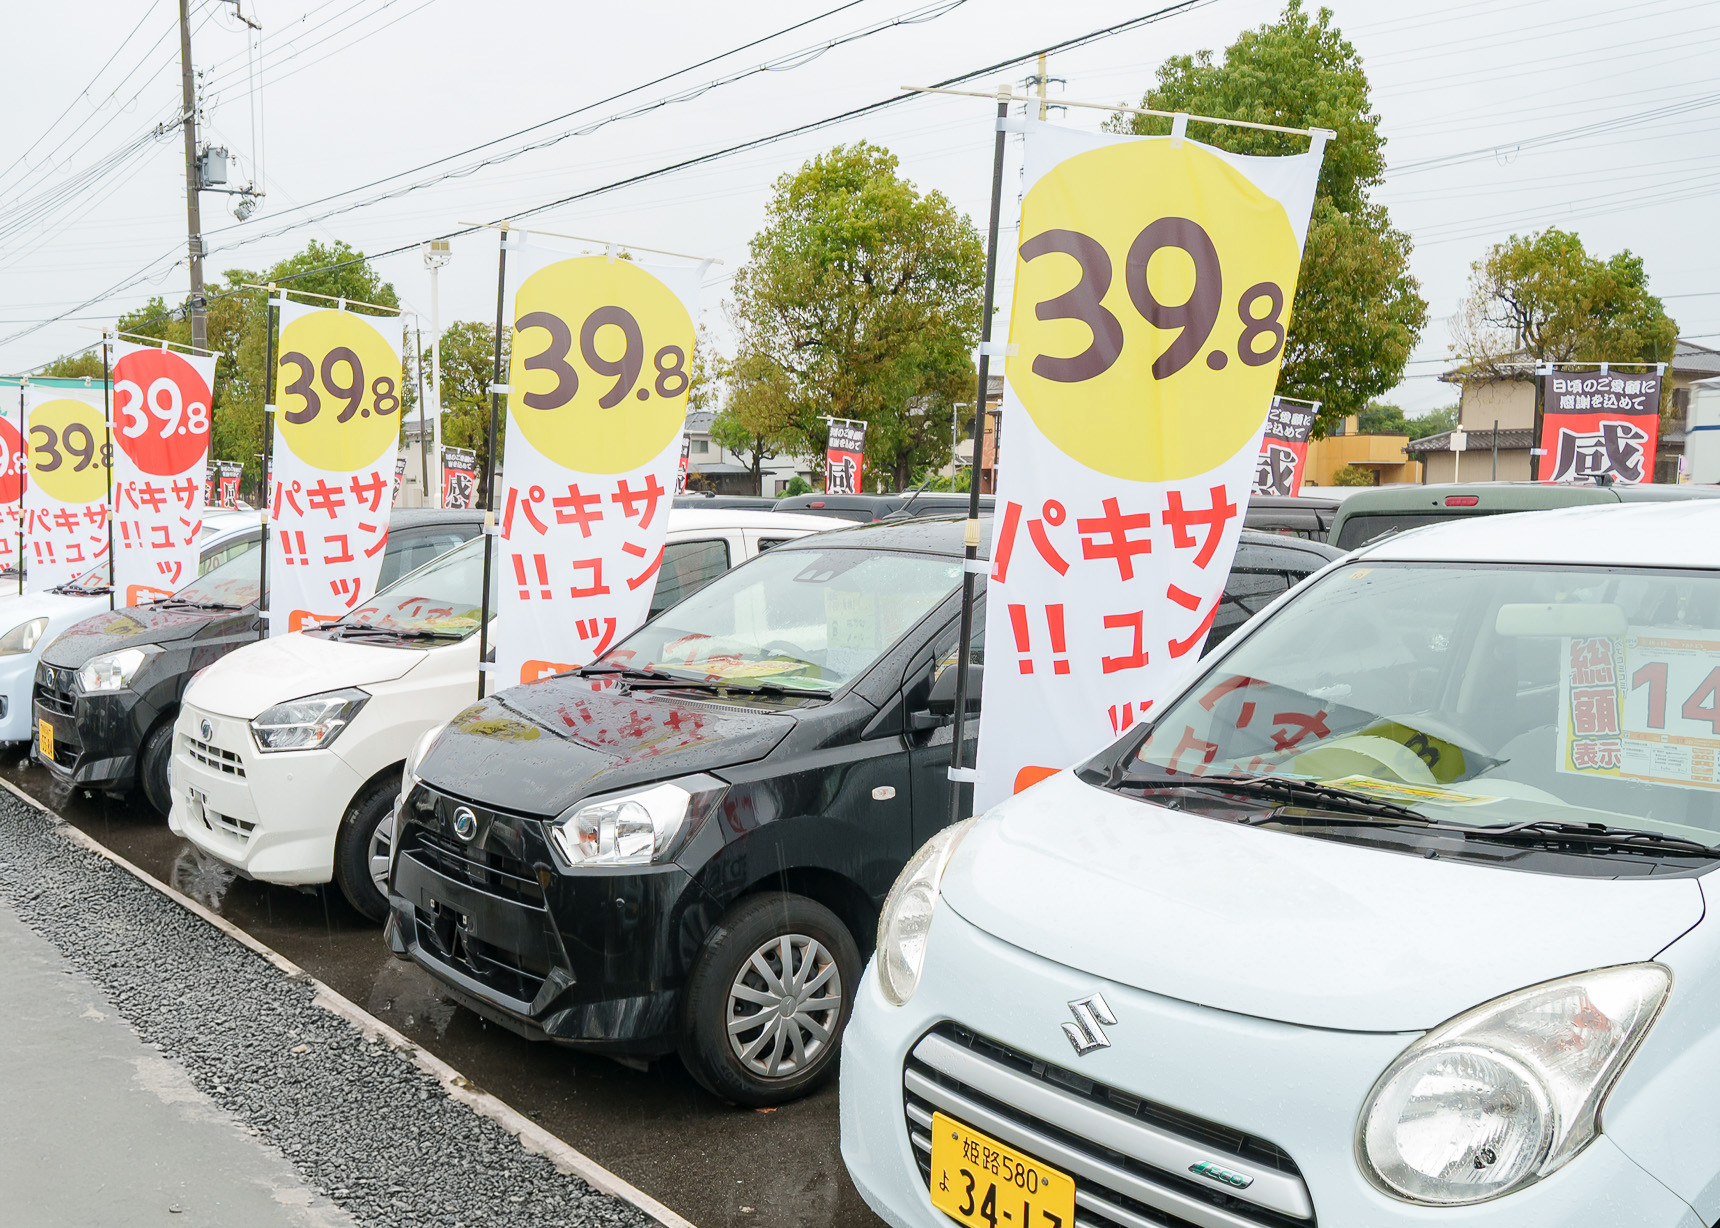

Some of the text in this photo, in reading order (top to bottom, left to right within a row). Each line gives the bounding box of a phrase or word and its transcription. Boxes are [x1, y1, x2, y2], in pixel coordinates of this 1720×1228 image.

[1018, 216, 1285, 383] 39.8
[279, 346, 400, 424] 39.8
[514, 305, 690, 410] 39.8
[1553, 376, 1656, 395] 日頃のご愛顧に
[113, 377, 209, 439] 39.8
[1559, 394, 1647, 410] 感謝を込めて
[29, 422, 114, 472] 39.8
[53, 508, 86, 579] キュ
[1574, 741, 1622, 767] 表示
[939, 1169, 950, 1192] よ
